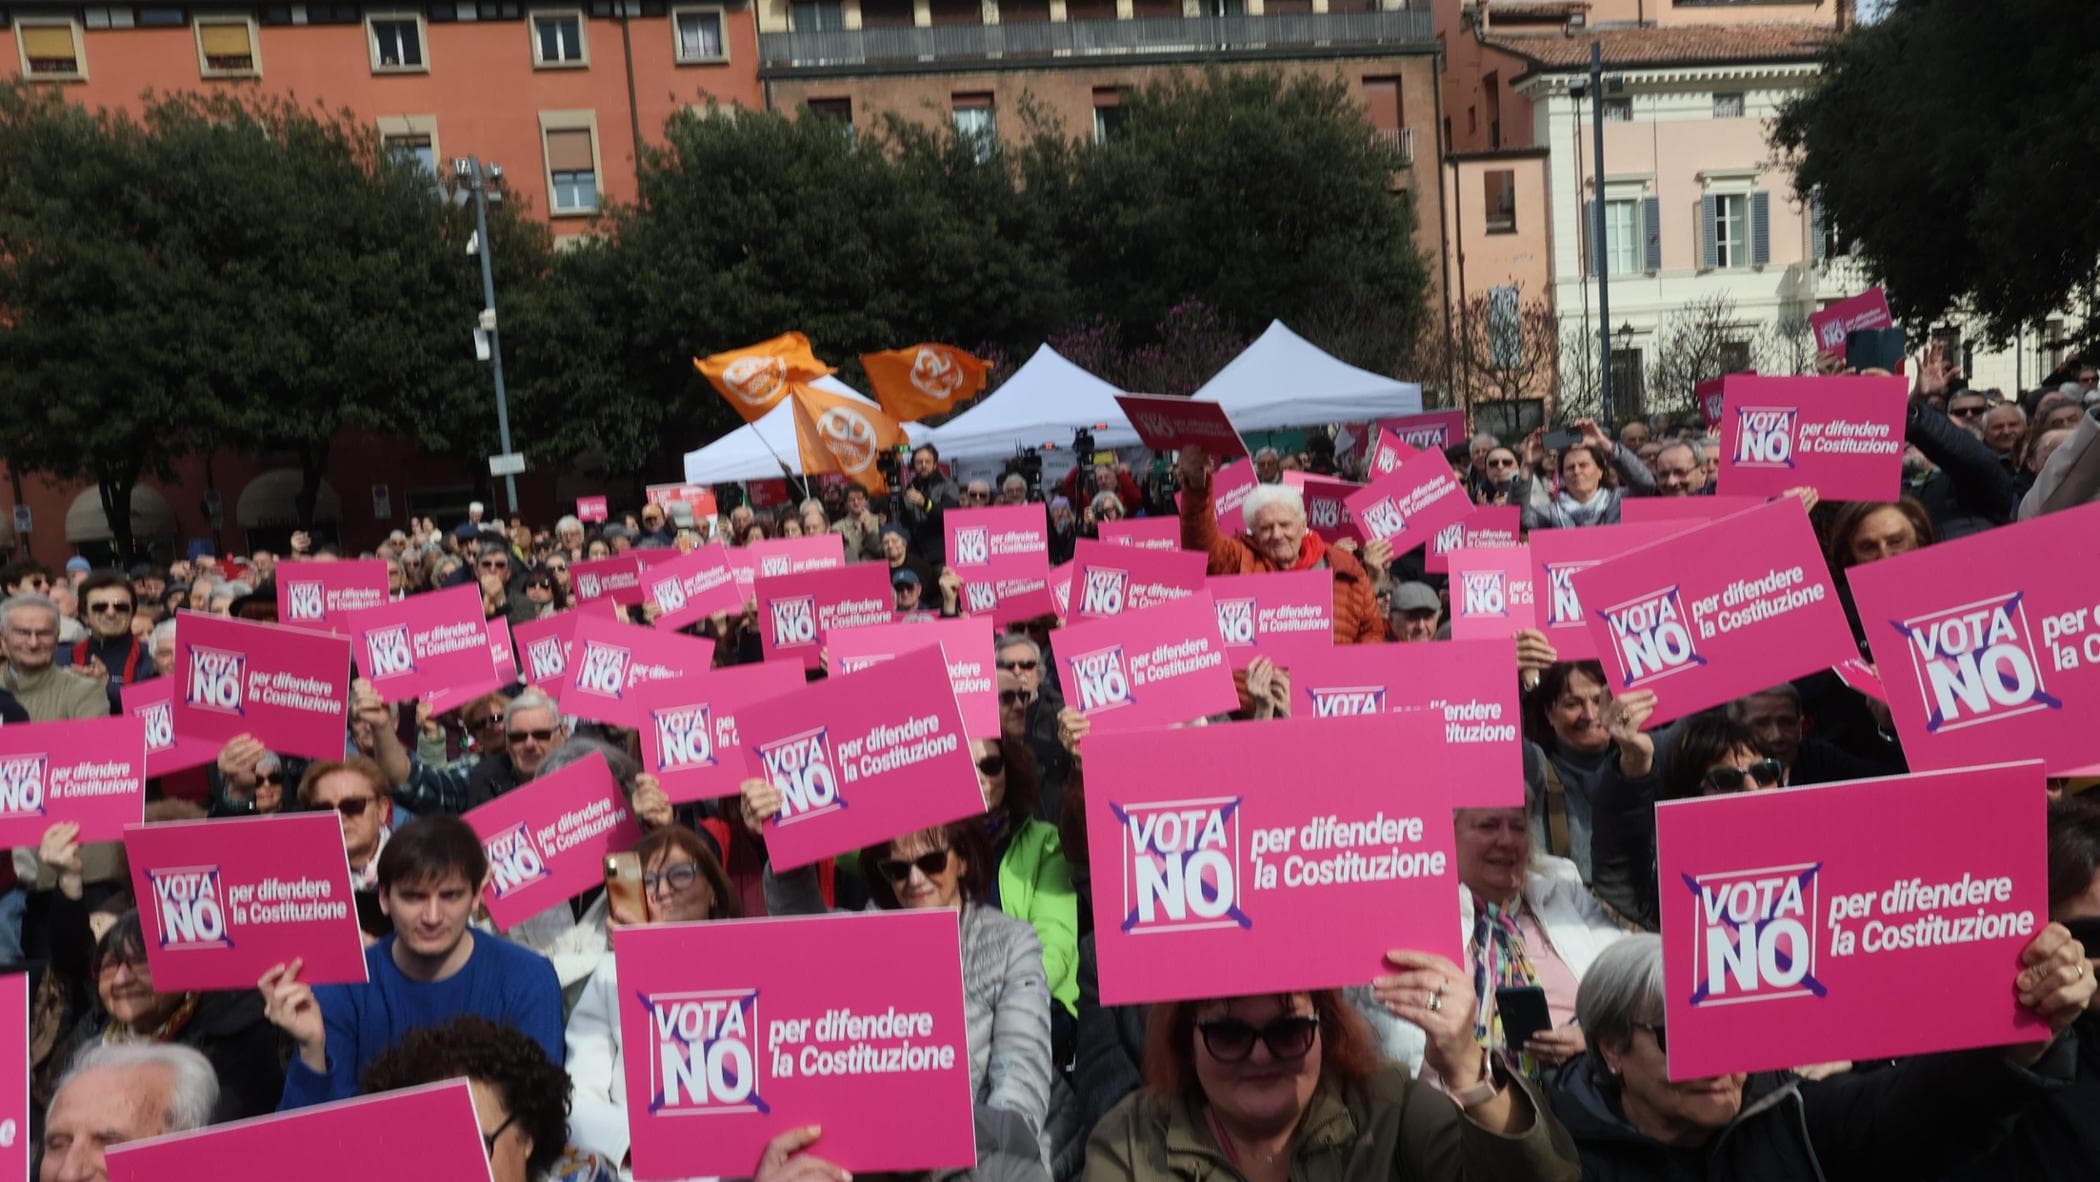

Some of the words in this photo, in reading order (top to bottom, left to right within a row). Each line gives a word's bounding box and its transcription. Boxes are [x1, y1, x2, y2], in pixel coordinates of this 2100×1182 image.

[1823, 331, 1846, 348] NO
[1741, 411, 1790, 432] VOTA
[1799, 421, 1824, 439] per
[1825, 419, 1890, 437] difendere
[1400, 429, 1442, 450] VOTA
[1740, 430, 1790, 463] NO
[1799, 437, 1812, 453] la
[1813, 436, 1899, 454] Costituzione
[1411, 474, 1446, 503] difendere
[1311, 509, 1338, 528] NO
[1364, 499, 1394, 523] VOTA
[957, 529, 985, 542] VOTA
[1371, 511, 1401, 540] NO
[958, 540, 987, 564] NO
[1437, 533, 1463, 554] NO
[290, 583, 320, 598] VOTA
[1087, 570, 1123, 590] VOTA
[1129, 583, 1147, 598] per
[1465, 574, 1501, 589] VOTA
[1509, 581, 1526, 594] per
[291, 596, 322, 619] NO
[819, 604, 836, 619] per
[836, 598, 883, 614] difendere
[970, 591, 996, 612] NO
[1084, 585, 1122, 615] NO
[1467, 588, 1504, 615] NO
[1510, 592, 1519, 605] la
[1554, 587, 1581, 622] N
[1692, 594, 1720, 625] per
[1723, 565, 1804, 606] difendere
[772, 600, 811, 621] VOTA
[821, 617, 831, 631] la
[831, 610, 892, 629] Costituzione
[1216, 602, 1251, 621] VOTA
[1259, 608, 1277, 622] per
[1277, 604, 1322, 620] difendere
[1610, 595, 1678, 637] VOTA
[1700, 619, 1716, 640] la
[1718, 582, 1825, 633] Costituzione
[369, 626, 405, 649] VOTA
[413, 630, 430, 646] per
[431, 621, 476, 642] difendere
[776, 617, 815, 645] NO
[1218, 617, 1252, 644] NO
[1259, 621, 1268, 633] la
[1269, 617, 1330, 632] Costituzione
[1912, 606, 2018, 661] VOTA
[2042, 607, 2088, 648] per
[372, 642, 411, 676] NO
[416, 645, 426, 659] la
[427, 631, 487, 656] Costituzione
[1130, 654, 1150, 672] per
[1152, 638, 1209, 666] difendere
[1621, 622, 1691, 679] NO
[2052, 640, 2080, 673] la
[194, 652, 240, 678] VOTA
[532, 653, 563, 681] NO
[581, 662, 622, 694] NO
[1073, 650, 1122, 681] VOTA
[1134, 670, 1145, 687] la
[1147, 651, 1222, 682] Costituzione
[192, 670, 240, 707] NO
[249, 670, 272, 690] per
[273, 671, 333, 697] difendere
[952, 676, 992, 694] uzione
[1079, 668, 1130, 710] NO
[1926, 643, 2036, 722] NO
[249, 688, 260, 702] la
[263, 689, 342, 715] Costituzione
[1317, 694, 1377, 717] VOTA
[658, 709, 706, 734] VOTA
[1445, 721, 1516, 744] tituzione
[146, 722, 173, 750] NO
[662, 728, 710, 767] NO
[718, 731, 729, 748] la
[838, 737, 863, 766] per
[866, 713, 939, 746] difendere
[763, 736, 825, 774] VOTA
[843, 763, 859, 784] la
[860, 732, 958, 776] Costituzione
[0, 758, 41, 782] VOTA
[50, 766, 72, 783] per
[73, 762, 131, 779] difendere
[0, 779, 42, 813] NO
[51, 782, 62, 799] la
[64, 776, 139, 797] Costituzione
[774, 764, 835, 818] NO
[536, 826, 557, 847] per
[557, 797, 612, 832] difendere
[543, 840, 557, 859] la
[556, 807, 627, 852] Costituzione
[1129, 808, 1228, 855] VOTA
[1250, 827, 1296, 864] per
[1299, 811, 1424, 846] difendere
[492, 847, 542, 892] NO
[1253, 856, 1278, 890] la
[1283, 848, 1447, 888] Costituzione
[157, 873, 215, 902] VOTA
[229, 883, 256, 904] per
[257, 876, 331, 902] difendere
[1134, 850, 1234, 923] NO
[1702, 876, 1805, 925] VOTA
[233, 903, 248, 926] la
[250, 900, 347, 925] Costituzione
[1828, 889, 1877, 929] per
[1881, 873, 2012, 914] difendere
[162, 899, 223, 943] NO
[1830, 924, 1855, 957] la
[1862, 909, 2034, 953] Costituzione
[1706, 918, 1809, 996] NO
[653, 1000, 747, 1042] VOTA
[768, 1017, 811, 1052] per
[815, 1006, 934, 1044] difendere
[660, 1038, 753, 1106] NO
[772, 1048, 793, 1079] la
[799, 1041, 955, 1077] Costituzione
